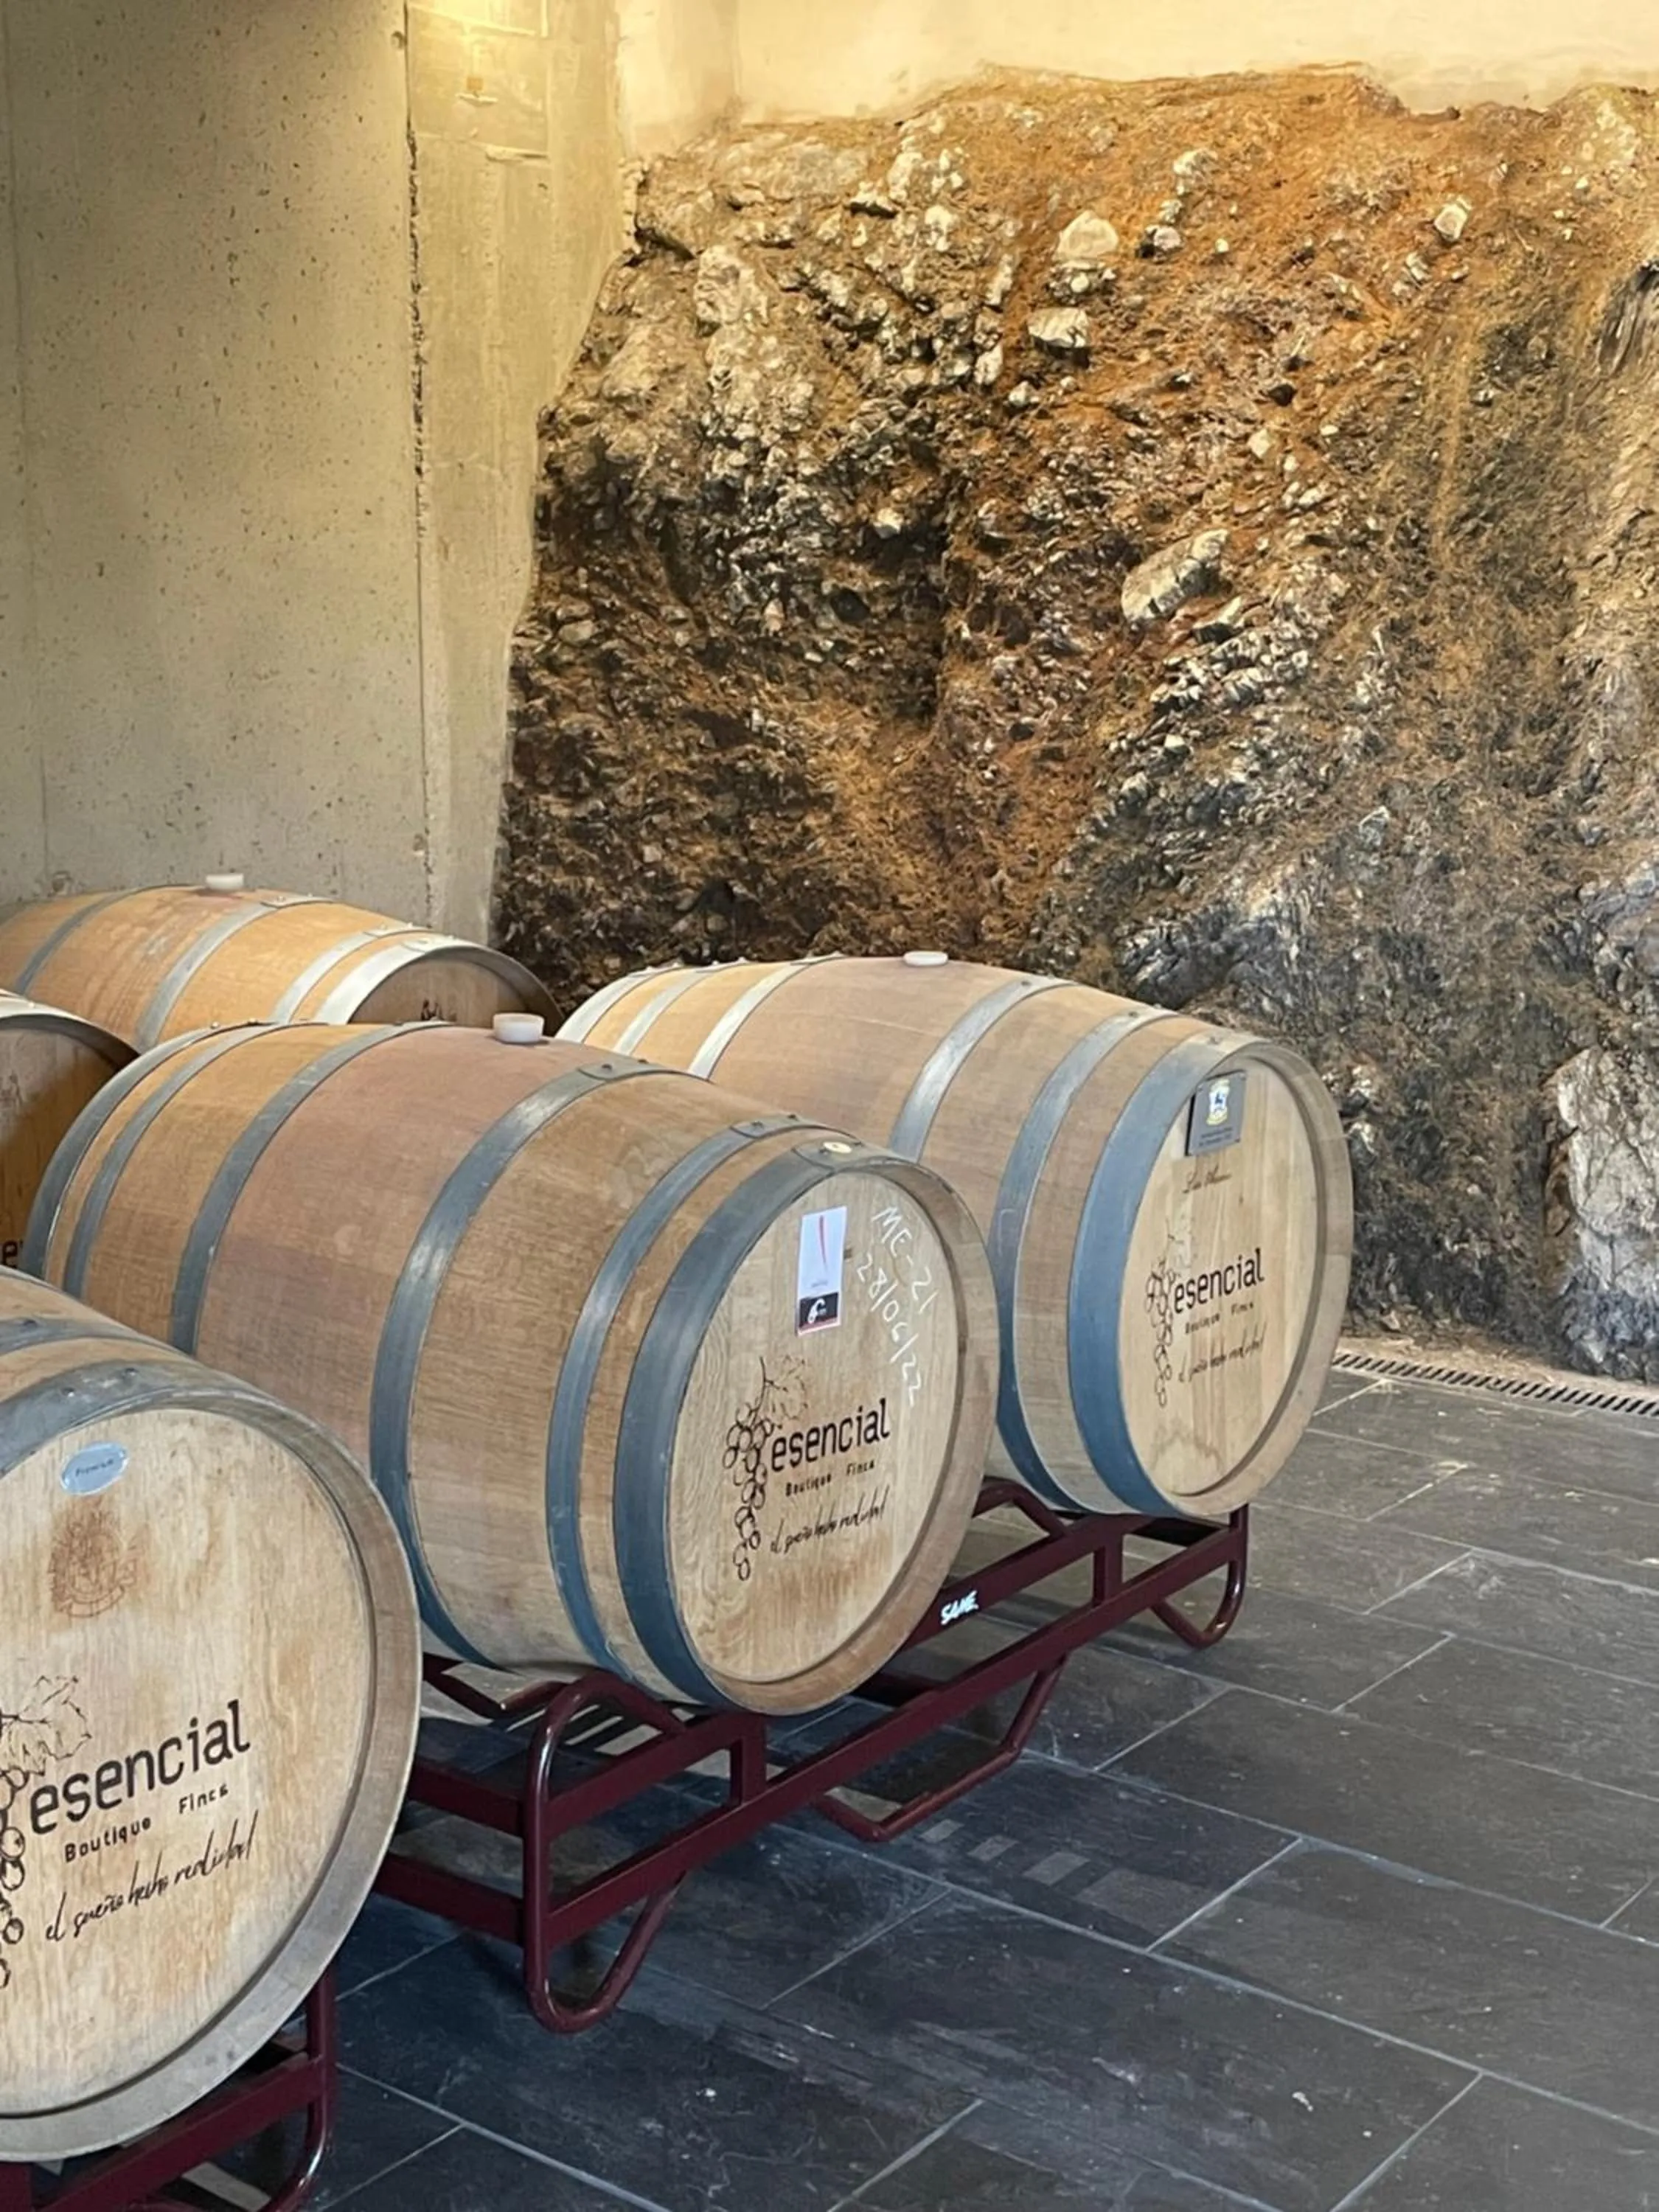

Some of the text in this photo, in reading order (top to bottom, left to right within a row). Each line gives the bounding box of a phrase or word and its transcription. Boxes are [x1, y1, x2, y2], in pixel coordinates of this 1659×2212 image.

[1174, 1247, 1265, 1314] esencial
[771, 1397, 890, 1472] esencial
[785, 1459, 875, 1497] Boutique Finca
[30, 1699, 251, 1835] esencial
[65, 1784, 229, 1863] Boutique Finca
[46, 1891, 67, 1941] el
